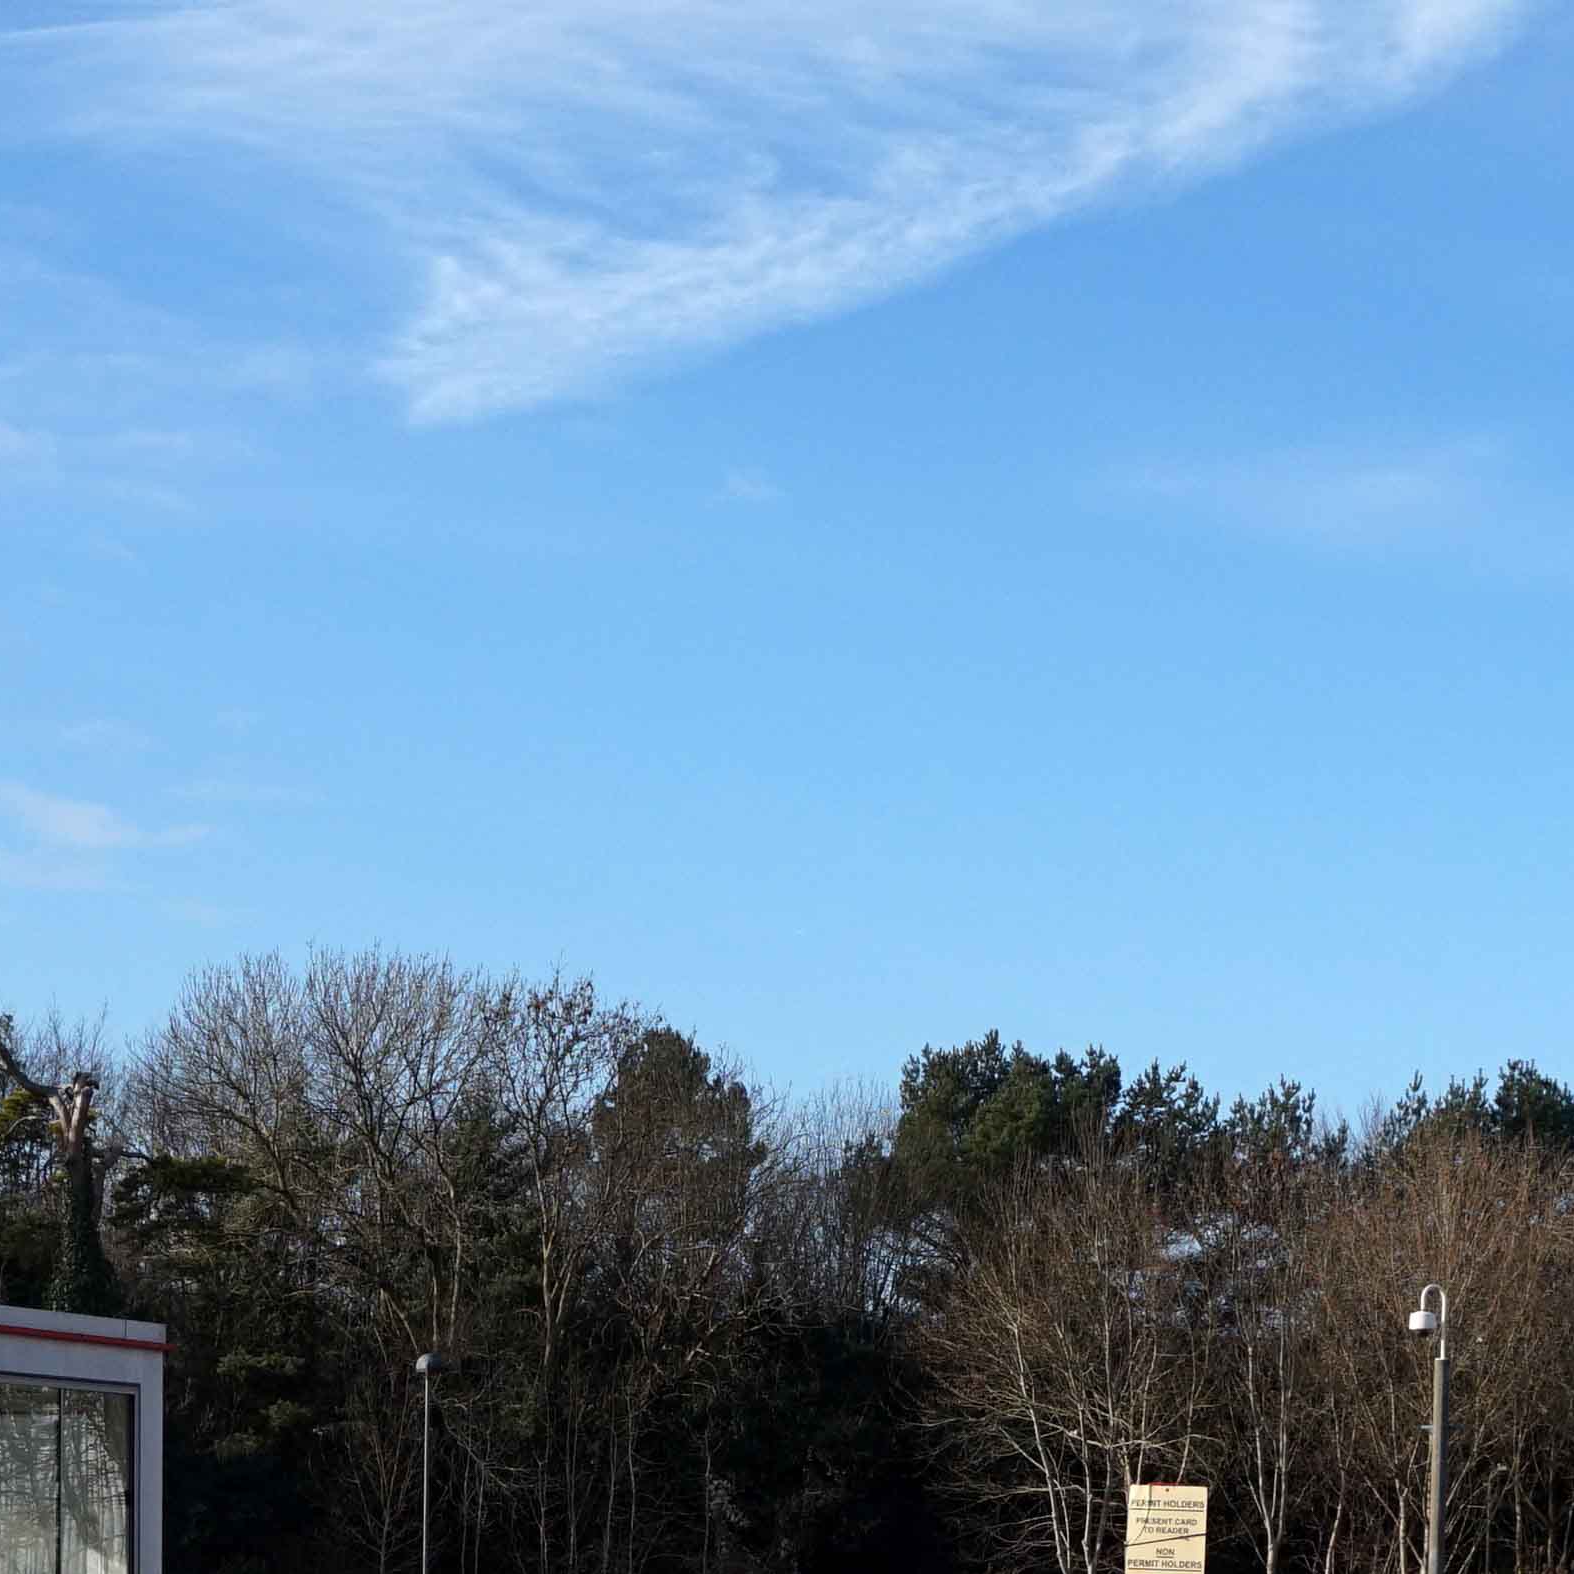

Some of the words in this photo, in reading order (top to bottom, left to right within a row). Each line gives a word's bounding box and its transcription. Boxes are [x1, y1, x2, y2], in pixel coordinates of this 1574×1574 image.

[1131, 1499, 1162, 1508] PERMIT
[1163, 1500, 1205, 1509] HOLDERS
[1137, 1517, 1173, 1526] PRESENT
[1175, 1518, 1198, 1526] CARD
[1156, 1527, 1189, 1535] READER
[1128, 1559, 1159, 1568] PERMIT
[1161, 1560, 1202, 1569] HOLDERS
